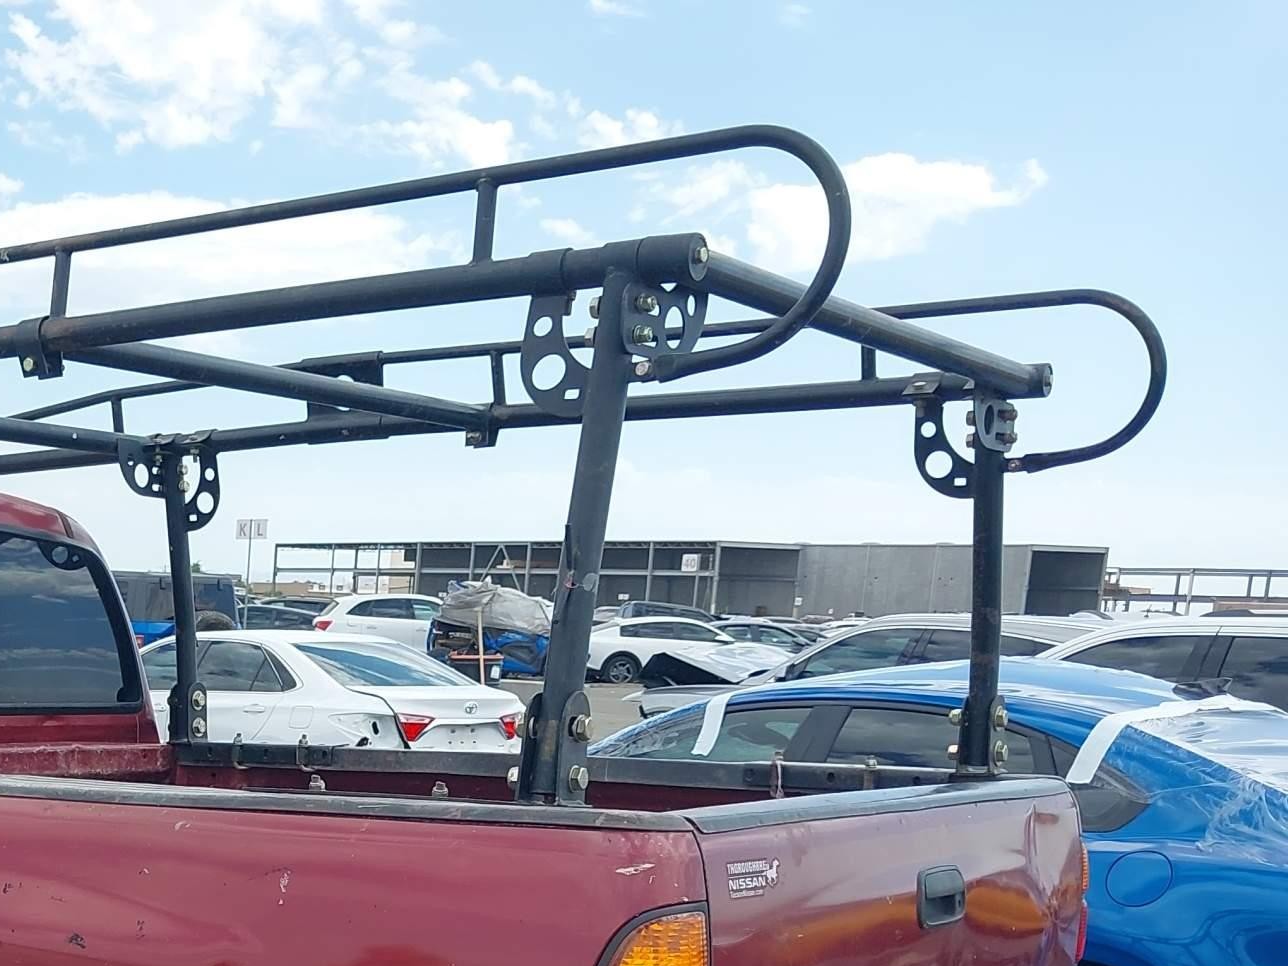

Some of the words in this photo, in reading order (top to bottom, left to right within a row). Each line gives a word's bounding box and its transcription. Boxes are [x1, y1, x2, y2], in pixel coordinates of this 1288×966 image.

[239, 522, 248, 536] K
[257, 522, 264, 536] L
[683, 558, 696, 569] 40
[728, 876, 766, 890] NISSAN
